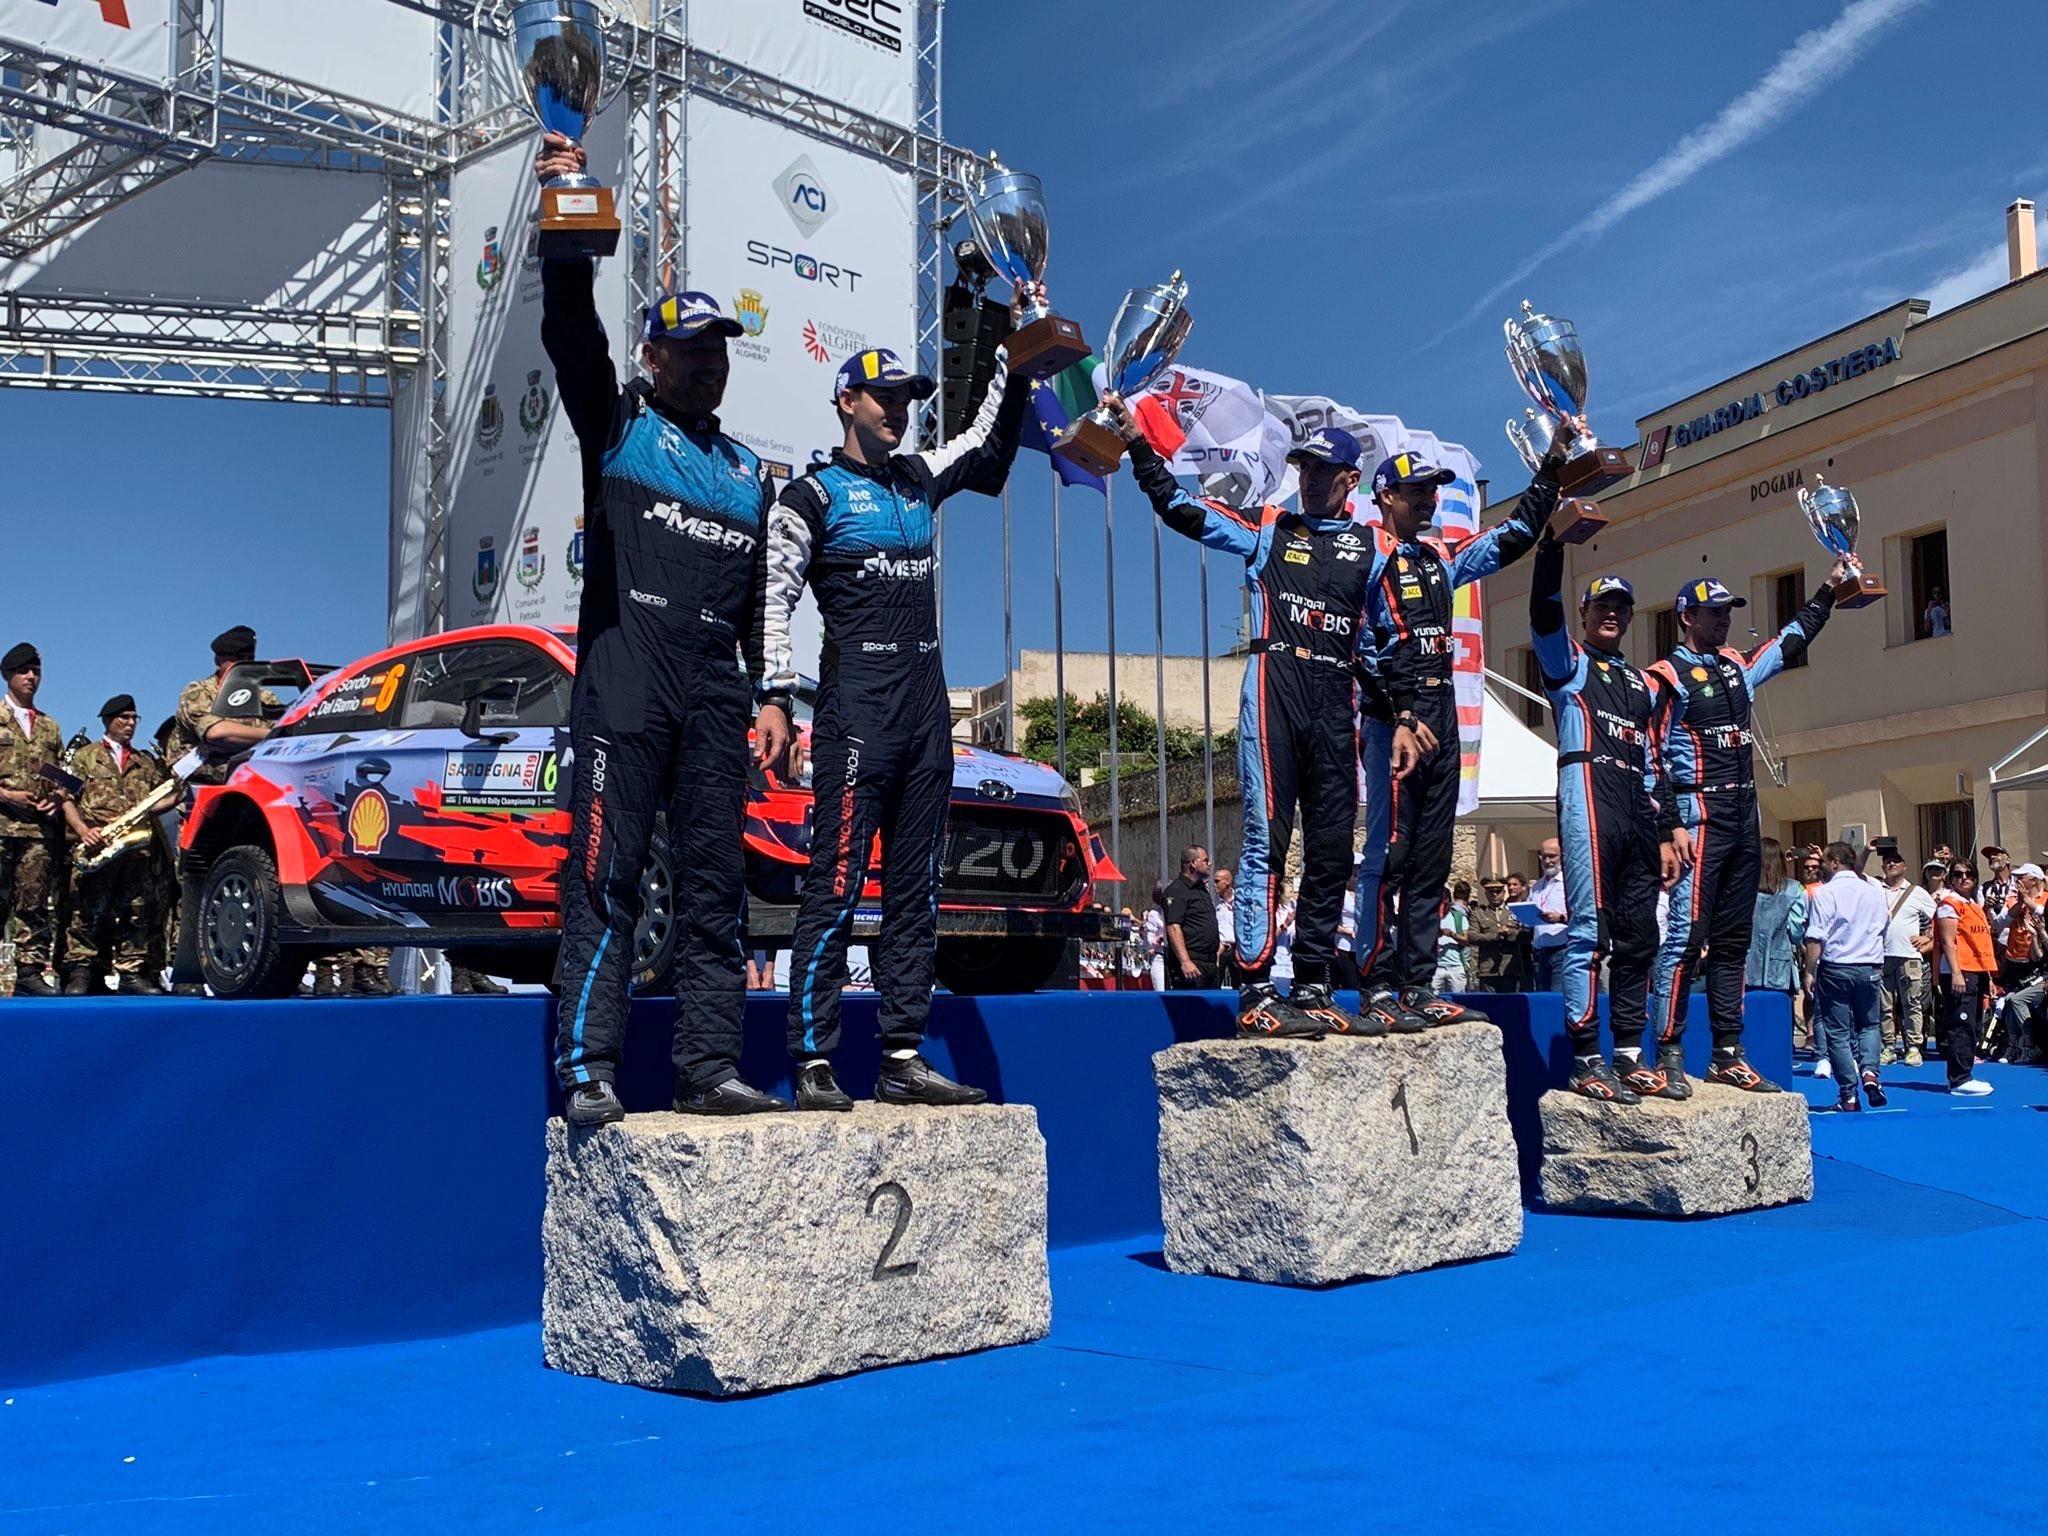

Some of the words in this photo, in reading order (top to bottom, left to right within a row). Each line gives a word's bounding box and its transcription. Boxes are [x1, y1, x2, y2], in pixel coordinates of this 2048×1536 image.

[804, 17, 899, 59] CHAMPIONSHIP
[805, 4, 822, 17] FIA
[823, 10, 862, 33] WORLD
[863, 29, 900, 50] RALLY
[793, 183, 827, 213] ACI
[747, 239, 862, 293] SPORT
[732, 338, 763, 354] COMUNE
[818, 320, 867, 343] FONDAZIONE
[735, 348, 768, 363] ALGHERO
[1675, 392, 1769, 448] GUARDIA
[1775, 336, 1902, 406] COSTIERA
[745, 434, 769, 449] Global
[769, 440, 794, 454] Servizi
[1750, 468, 1804, 502] DOGANA
[1286, 551, 1311, 564] RACC
[515, 599, 535, 610] Comune
[1279, 590, 1326, 610] HYUNDAI
[519, 611, 541, 622] Pattada
[1290, 604, 1351, 636] MOBIS
[375, 663, 406, 713] 6
[332, 696, 360, 713] Barrio
[1597, 709, 1636, 729] HYUNDAI
[447, 763, 521, 778] SARDEGNA
[523, 755, 538, 787] 2019
[543, 752, 558, 792] 6
[592, 748, 607, 793] FORD
[846, 747, 859, 786] FORD
[473, 796, 487, 806] World
[488, 797, 501, 807] Rally
[501, 797, 536, 808] Championship
[381, 882, 435, 899] HYUNDAI
[436, 875, 512, 909] MOBIS
[1391, 1083, 1419, 1156] 1
[1740, 1132, 1760, 1195] 3
[865, 1181, 919, 1281] 2
